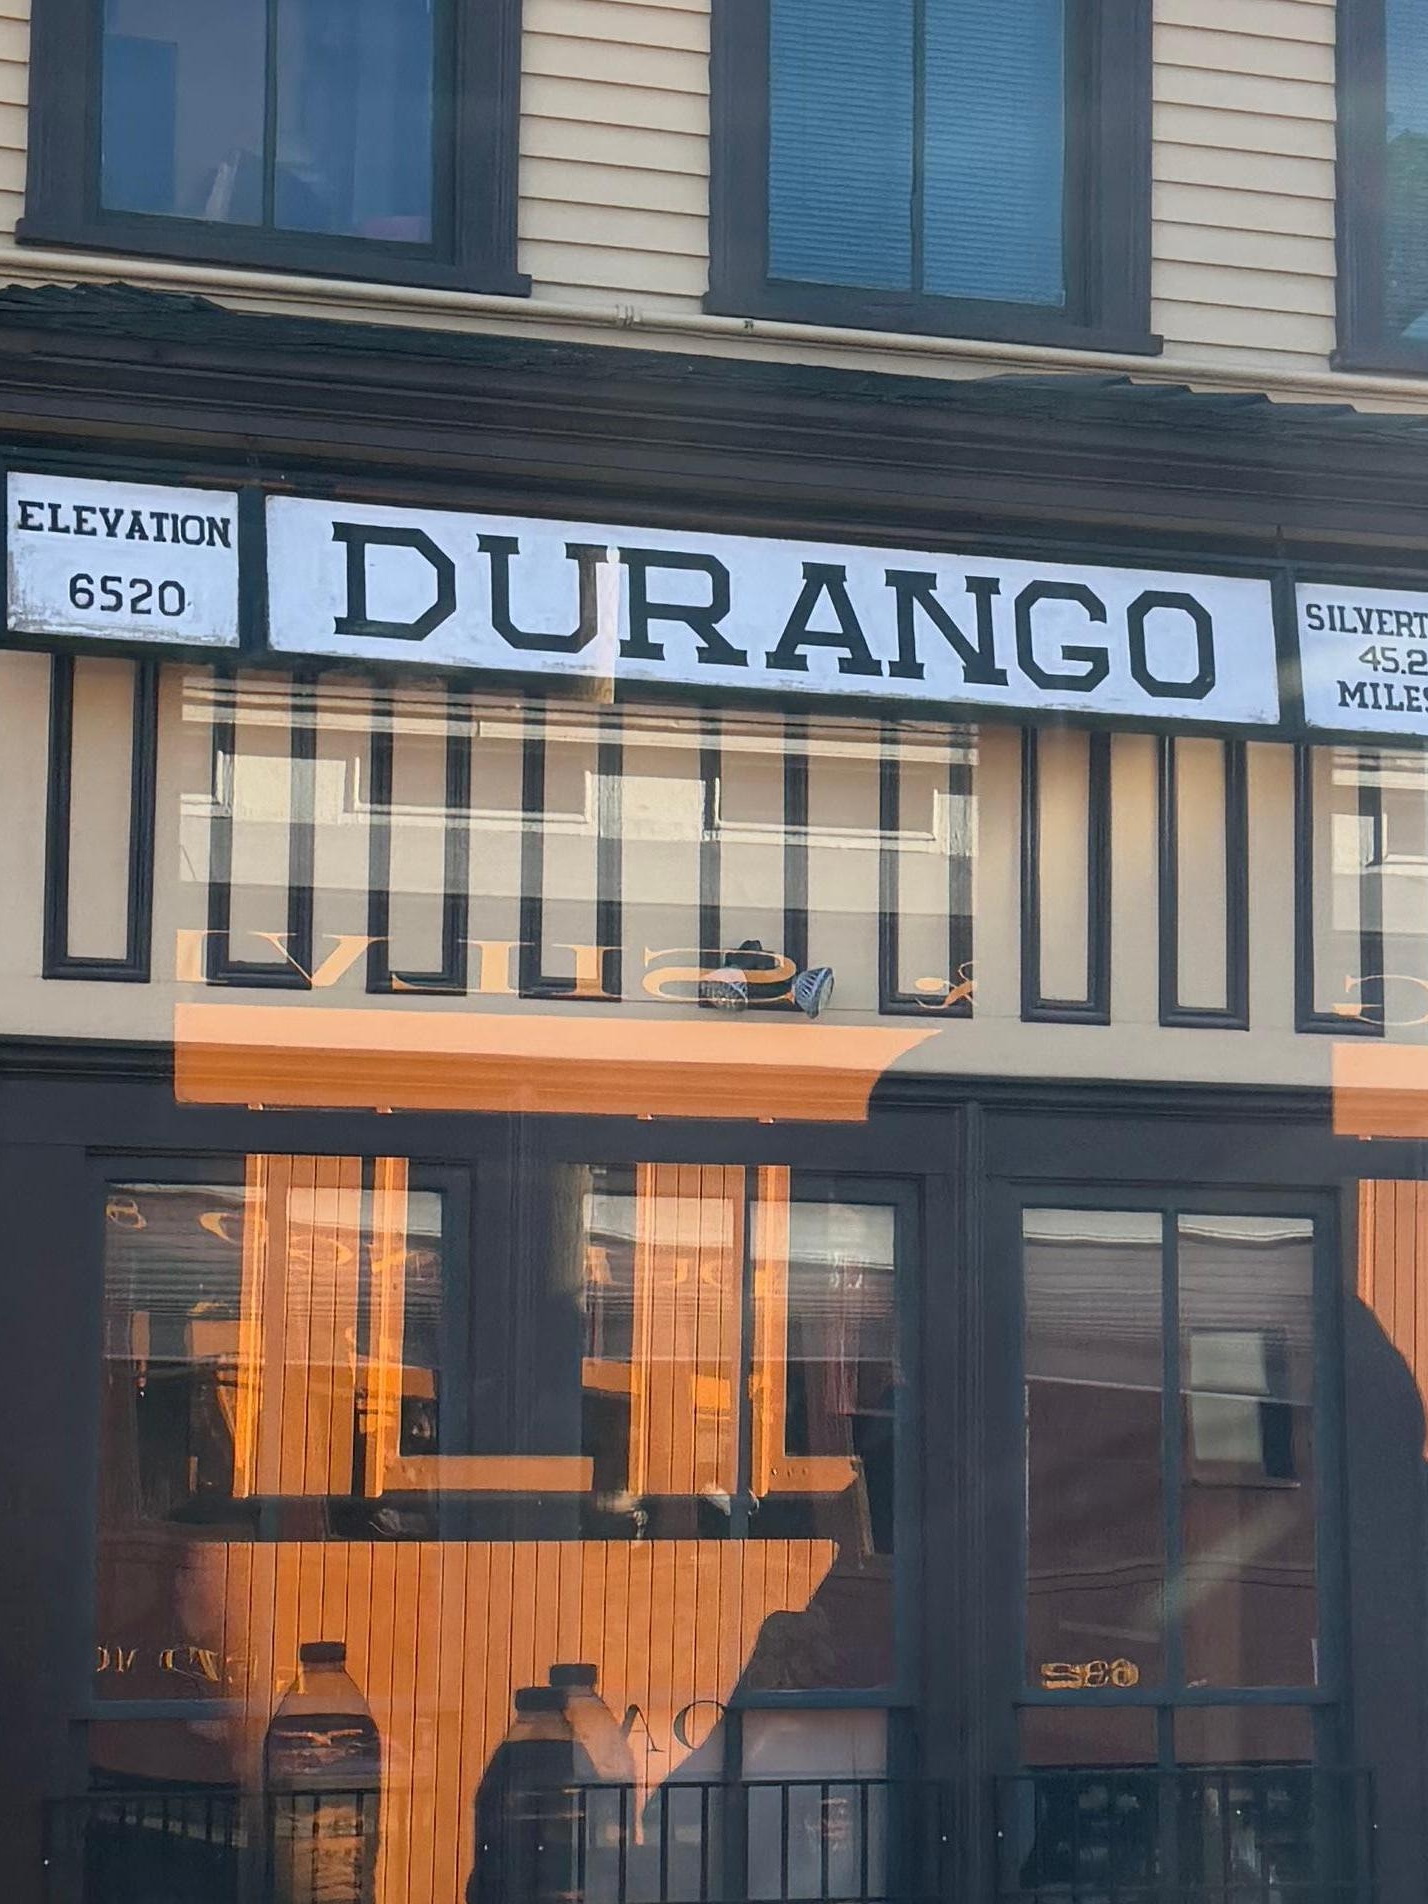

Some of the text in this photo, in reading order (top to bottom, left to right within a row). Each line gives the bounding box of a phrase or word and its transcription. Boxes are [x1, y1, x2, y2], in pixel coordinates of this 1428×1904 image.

[17, 499, 232, 549] ELEVATION
[69, 573, 186, 617] 6520
[331, 520, 1215, 700] DURANGO
